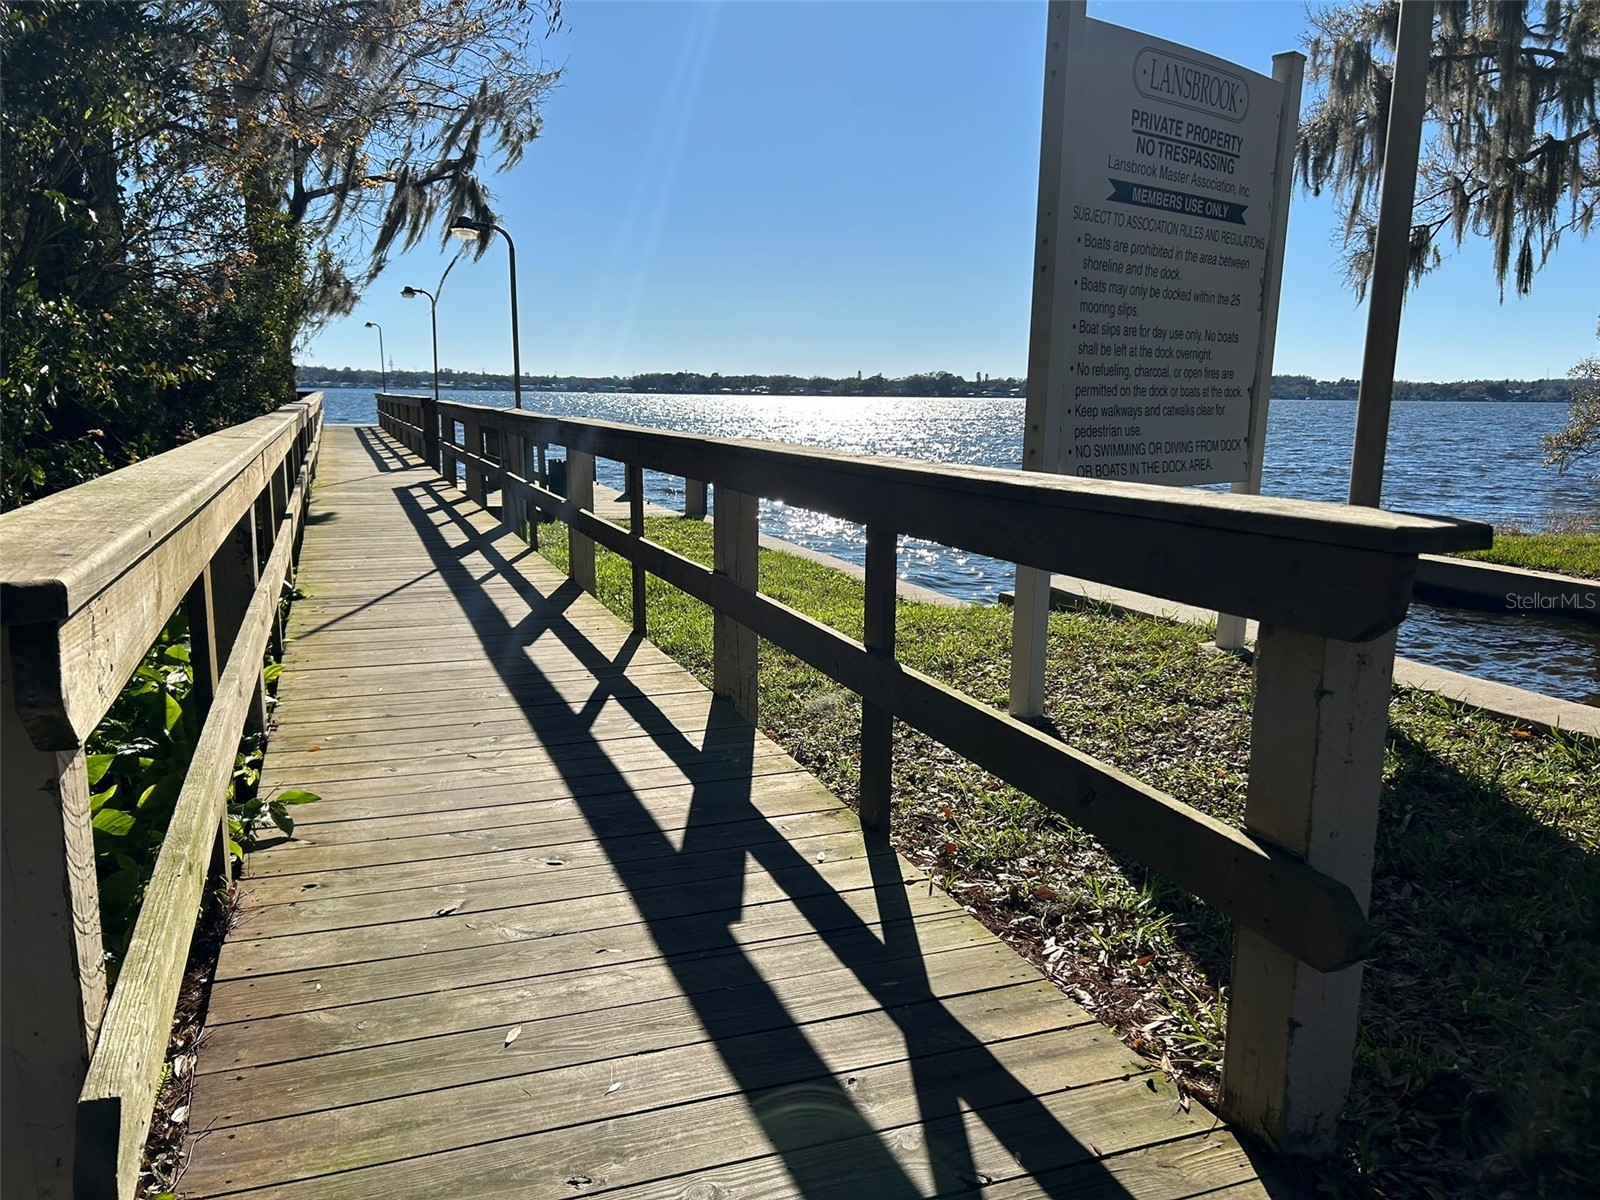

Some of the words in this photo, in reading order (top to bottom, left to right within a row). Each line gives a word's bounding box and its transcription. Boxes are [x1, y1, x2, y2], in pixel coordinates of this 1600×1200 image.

[1150, 58, 1240, 113] LANSBROOK
[1131, 109, 1182, 137] PRIVATE
[1186, 124, 1243, 152] PROPERTY
[1136, 137, 1154, 156] NO
[1158, 141, 1235, 174] TRESPASSING
[1108, 154, 1157, 178] Lansbrook
[1159, 166, 1189, 184] Master
[1191, 171, 1237, 195] Association,
[1239, 185, 1251, 198] Inc.
[1132, 188, 1182, 210] MEMBERS
[1185, 197, 1203, 213] USE
[1205, 201, 1229, 218] ONLY
[1073, 205, 1112, 224] SUBJECT
[1114, 212, 1125, 227] TO
[1126, 214, 1178, 235] ASSOCIATION
[1180, 223, 1203, 239] RULES
[1204, 227, 1219, 242] AND
[1221, 230, 1265, 249] REGULATIONS
[1084, 233, 1111, 250] Boats
[1113, 241, 1128, 252] are
[1130, 242, 1173, 260] prohibited
[1175, 247, 1183, 260] in
[1185, 248, 1197, 262] the
[1200, 254, 1217, 265] area
[1219, 253, 1249, 269] between
[1083, 256, 1122, 273] shoreline
[1125, 261, 1142, 275] and
[1144, 263, 1158, 277] the
[1161, 265, 1182, 280] dock.
[1081, 277, 1106, 292] Boats
[1109, 283, 1127, 299] may
[1130, 284, 1148, 300] only
[1150, 285, 1161, 298] be
[1163, 286, 1191, 301] docked
[1193, 292, 1215, 304] within
[1218, 294, 1229, 305] the
[1230, 294, 1240, 306] 25
[1080, 301, 1115, 317] mooring
[1118, 303, 1139, 319] slips.
[1079, 320, 1099, 335] Boat
[1101, 321, 1121, 338] slips
[1123, 325, 1137, 336] are
[1139, 323, 1150, 338] for
[1152, 324, 1167, 341] day
[1169, 328, 1184, 339] use
[1185, 327, 1202, 343] only.
[1204, 329, 1215, 342] No
[1218, 330, 1239, 343] boats
[1078, 342, 1098, 355] shall
[1101, 343, 1111, 356] be
[1114, 343, 1127, 357] left
[1129, 344, 1138, 357] at
[1139, 345, 1152, 358] the
[1155, 345, 1174, 358] dock
[1176, 348, 1213, 363] overnight.
[1077, 363, 1089, 376] No
[1092, 362, 1131, 380] refueling,
[1134, 365, 1171, 380] charcoal,
[1174, 369, 1181, 379] or
[1184, 369, 1202, 381] open
[1204, 367, 1220, 380] fires
[1221, 369, 1234, 379] are
[1075, 385, 1117, 400] permitted
[1120, 386, 1130, 396] on
[1133, 385, 1147, 397] the
[1150, 385, 1168, 397] dock
[1170, 387, 1177, 397] or
[1180, 385, 1200, 398] boats
[1202, 386, 1209, 397] at
[1211, 386, 1222, 397] the
[1224, 386, 1242, 398] dock.
[1075, 405, 1098, 419] Keep
[1101, 405, 1142, 419] walkways
[1145, 405, 1161, 416] and
[1162, 405, 1195, 416] catwalks
[1196, 404, 1214, 415] clear
[1215, 404, 1225, 415] for
[1075, 425, 1122, 440] pedestrian
[1125, 426, 1143, 436] use.
[1076, 446, 1091, 458] NO
[1094, 444, 1146, 457] SWIMMING
[1150, 444, 1162, 455] OR
[1165, 441, 1193, 454] DIVING
[1196, 440, 1218, 453] FROM
[1220, 439, 1241, 451] DOCK
[1077, 465, 1092, 477] OR
[1095, 463, 1128, 477] BOATS
[1130, 462, 1139, 475] IN
[1141, 461, 1159, 474] THE
[1162, 460, 1188, 473] DOCK
[1189, 459, 1212, 471] AREA.
